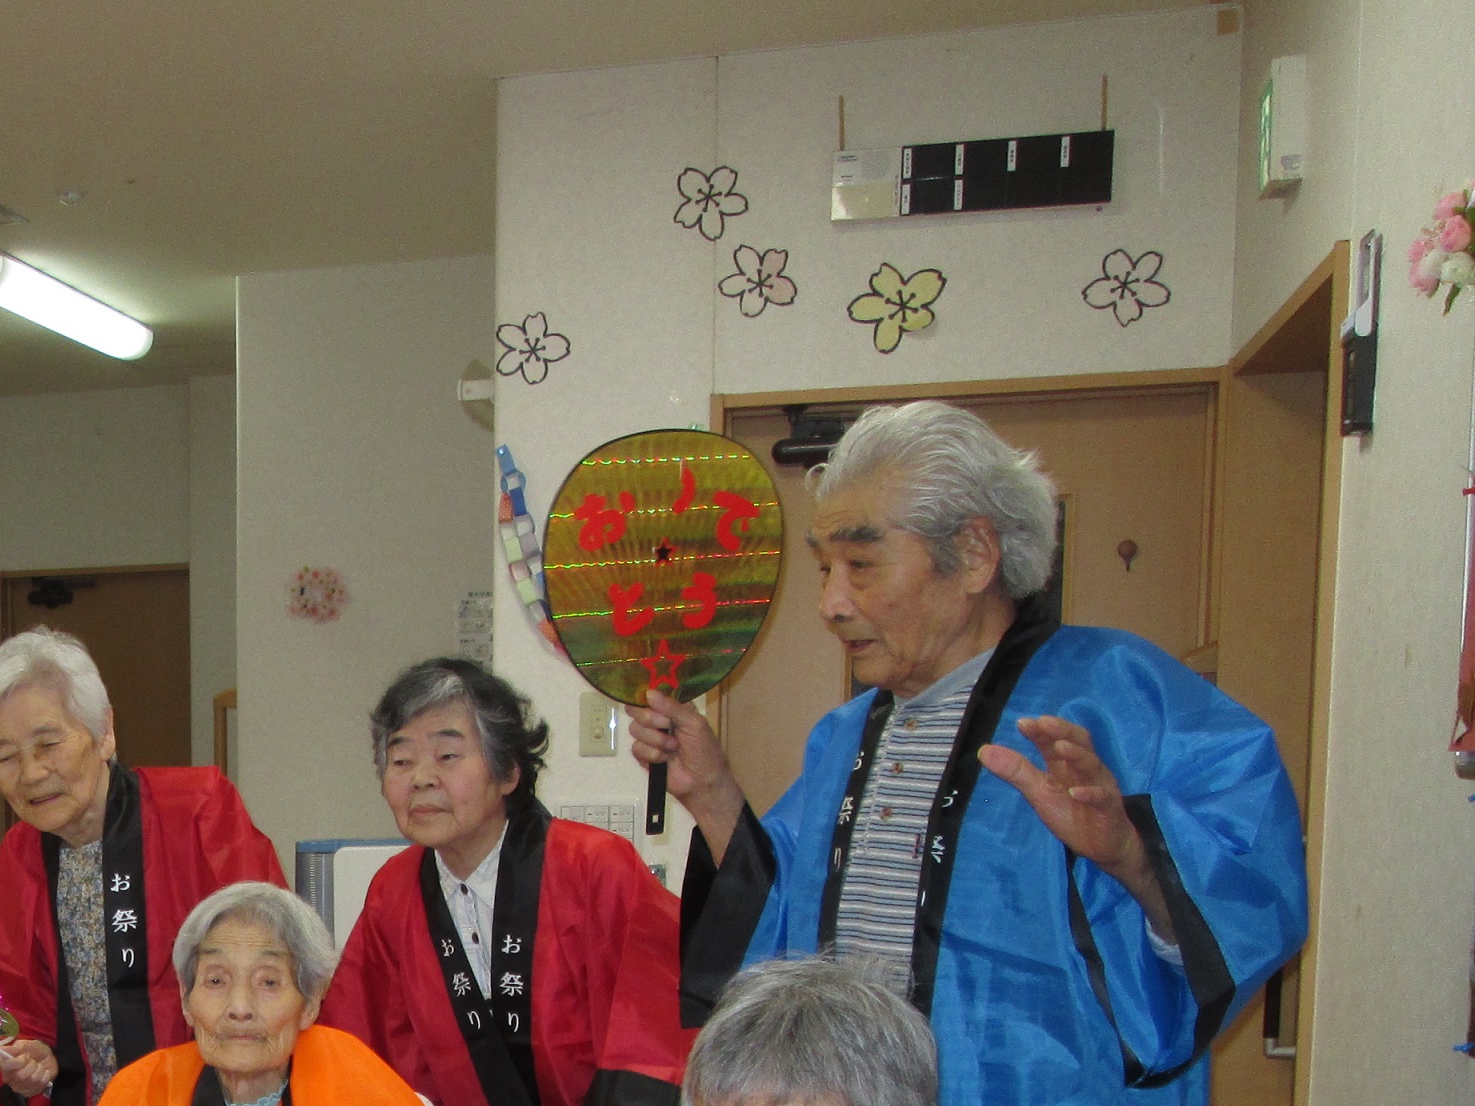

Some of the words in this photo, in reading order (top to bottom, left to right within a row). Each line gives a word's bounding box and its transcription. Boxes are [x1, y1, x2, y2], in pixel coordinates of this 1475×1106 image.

[608, 572, 717, 636] とう
[110, 872, 139, 968] お祭り
[441, 938, 482, 1030] お祭り
[499, 934, 525, 1033] お祭り
